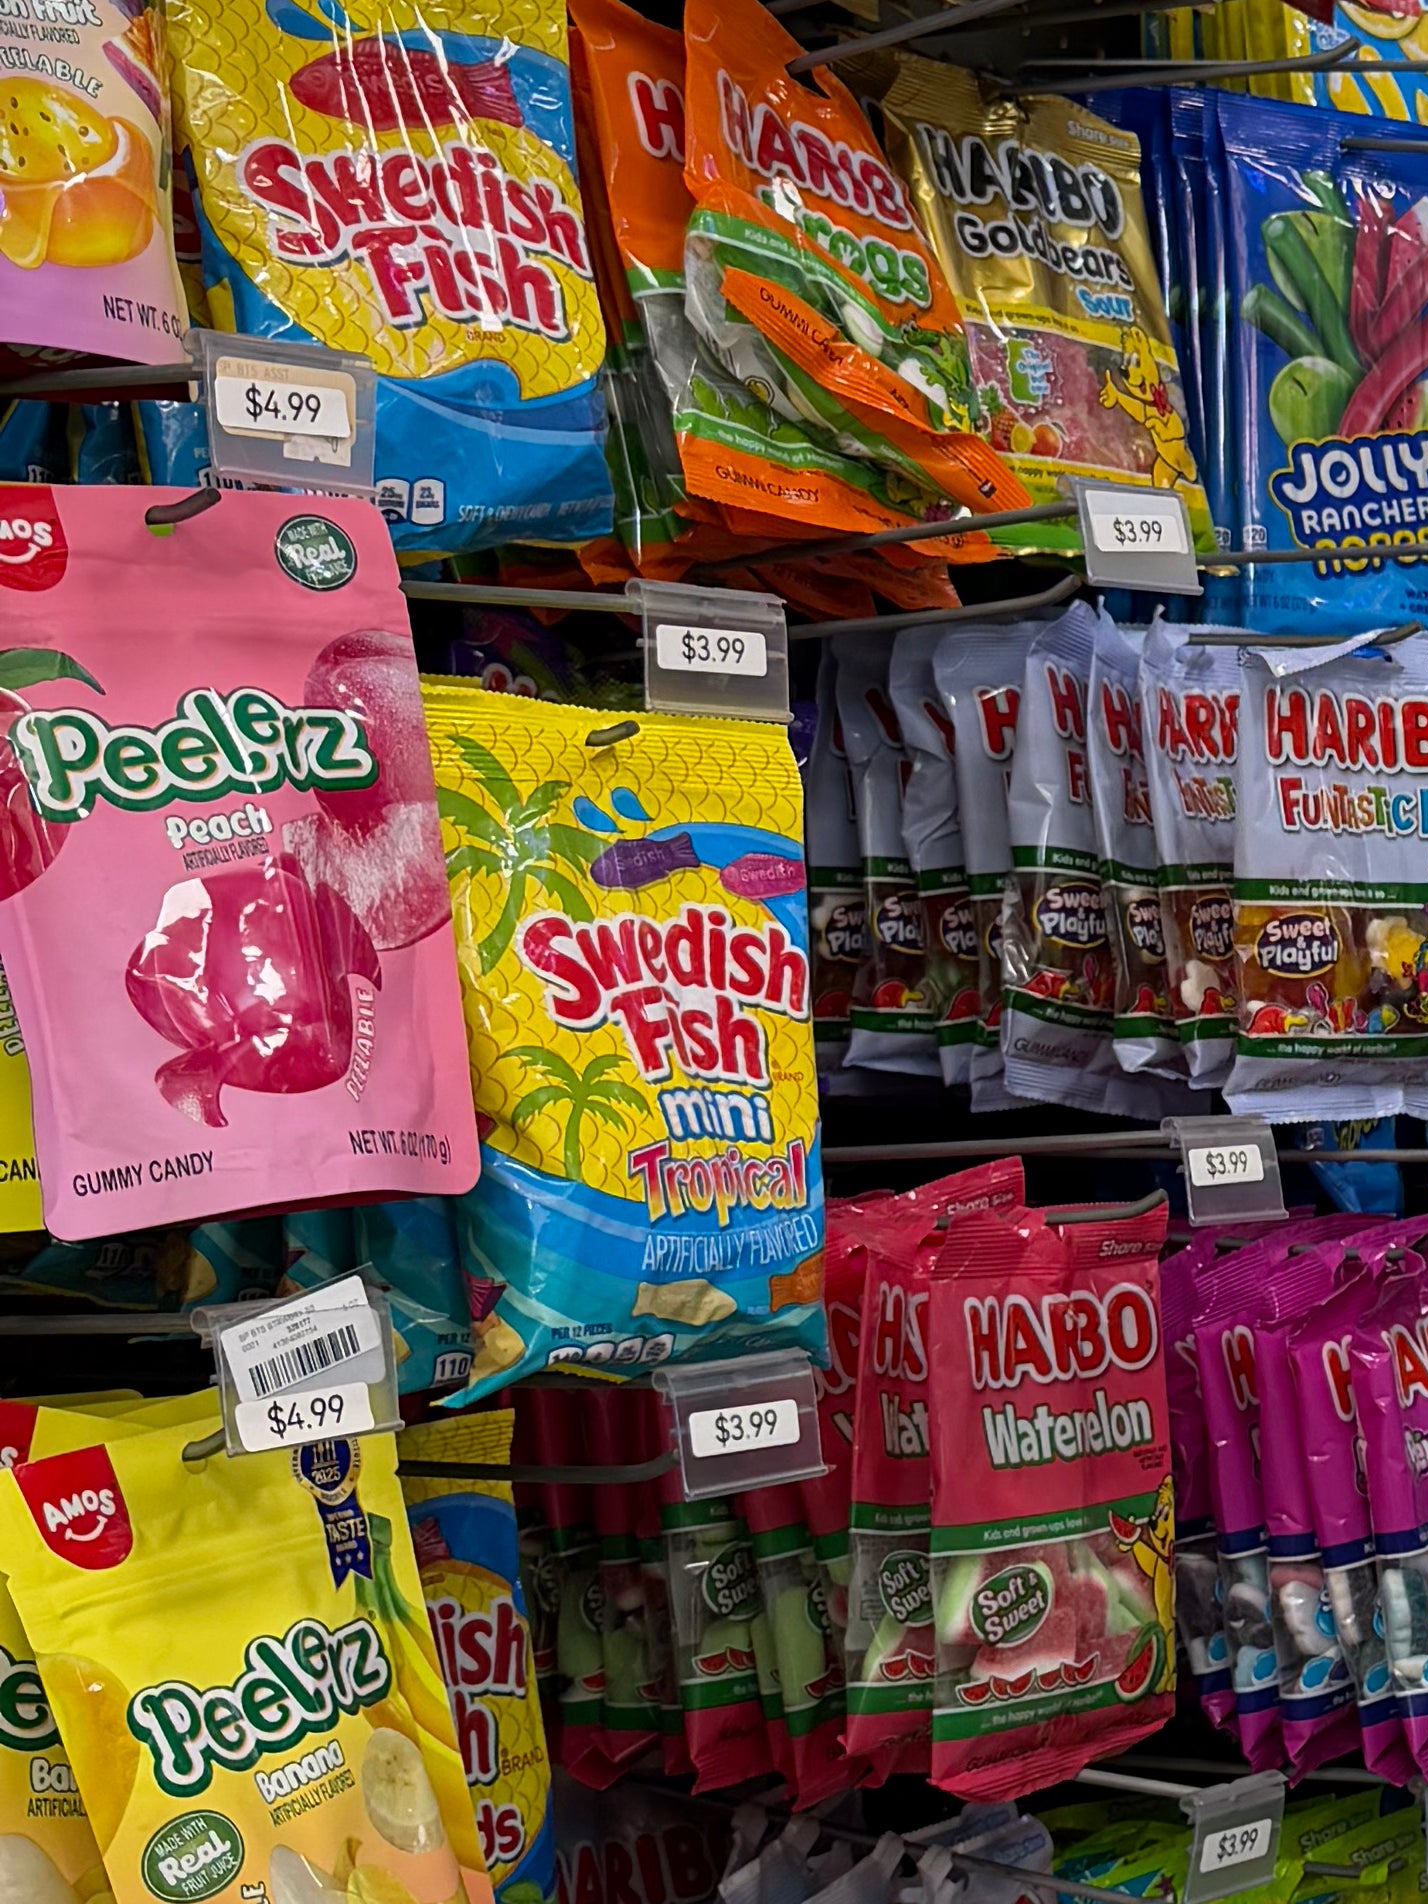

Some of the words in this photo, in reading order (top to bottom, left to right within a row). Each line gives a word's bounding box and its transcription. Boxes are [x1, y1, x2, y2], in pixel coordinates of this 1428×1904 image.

[241, 140, 594, 280] Swedish
[957, 216, 1130, 291] Goldbears
[352, 224, 569, 342] Fish
[103, 294, 133, 322] NET
[163, 309, 172, 334] 6
[1083, 294, 1132, 322] Sour
[244, 385, 322, 423] $4.99
[289, 536, 347, 565] Real
[1113, 519, 1164, 545] $3.99
[681, 636, 745, 664] $3.99
[10, 688, 378, 823] Peelerz
[165, 804, 272, 848] Peach
[1265, 918, 1333, 943] Sweet
[517, 902, 810, 1019] Swedish
[1259, 940, 1340, 970] Playful
[611, 981, 771, 1087] Fish
[660, 1086, 771, 1143] mini
[350, 1130, 378, 1154] NET
[73, 1167, 142, 1197] GUMMY
[151, 1150, 215, 1184] CANDY
[628, 1138, 810, 1228] Tropical
[1207, 1152, 1249, 1178] $3.99
[643, 1231, 749, 1272] ARTIFICIALLY
[749, 1214, 820, 1262] FLAVORED
[1100, 1238, 1140, 1258] Share
[267, 1394, 346, 1438] $4.99
[714, 1410, 779, 1445] $3.99
[43, 1488, 117, 1534] AMOS
[325, 1518, 366, 1545] TASTE
[977, 1571, 1020, 1614] Soft
[984, 1591, 1047, 1645] Sweet
[127, 1616, 394, 1798] Peelerz
[254, 1738, 345, 1806] Banana
[154, 1827, 182, 1859] MADE
[181, 1815, 208, 1843] WITH
[1217, 1829, 1259, 1860] $3.99
[156, 1836, 234, 1888] Real
[181, 1871, 211, 1899] FRUIT
[210, 1851, 240, 1884] JUICE
